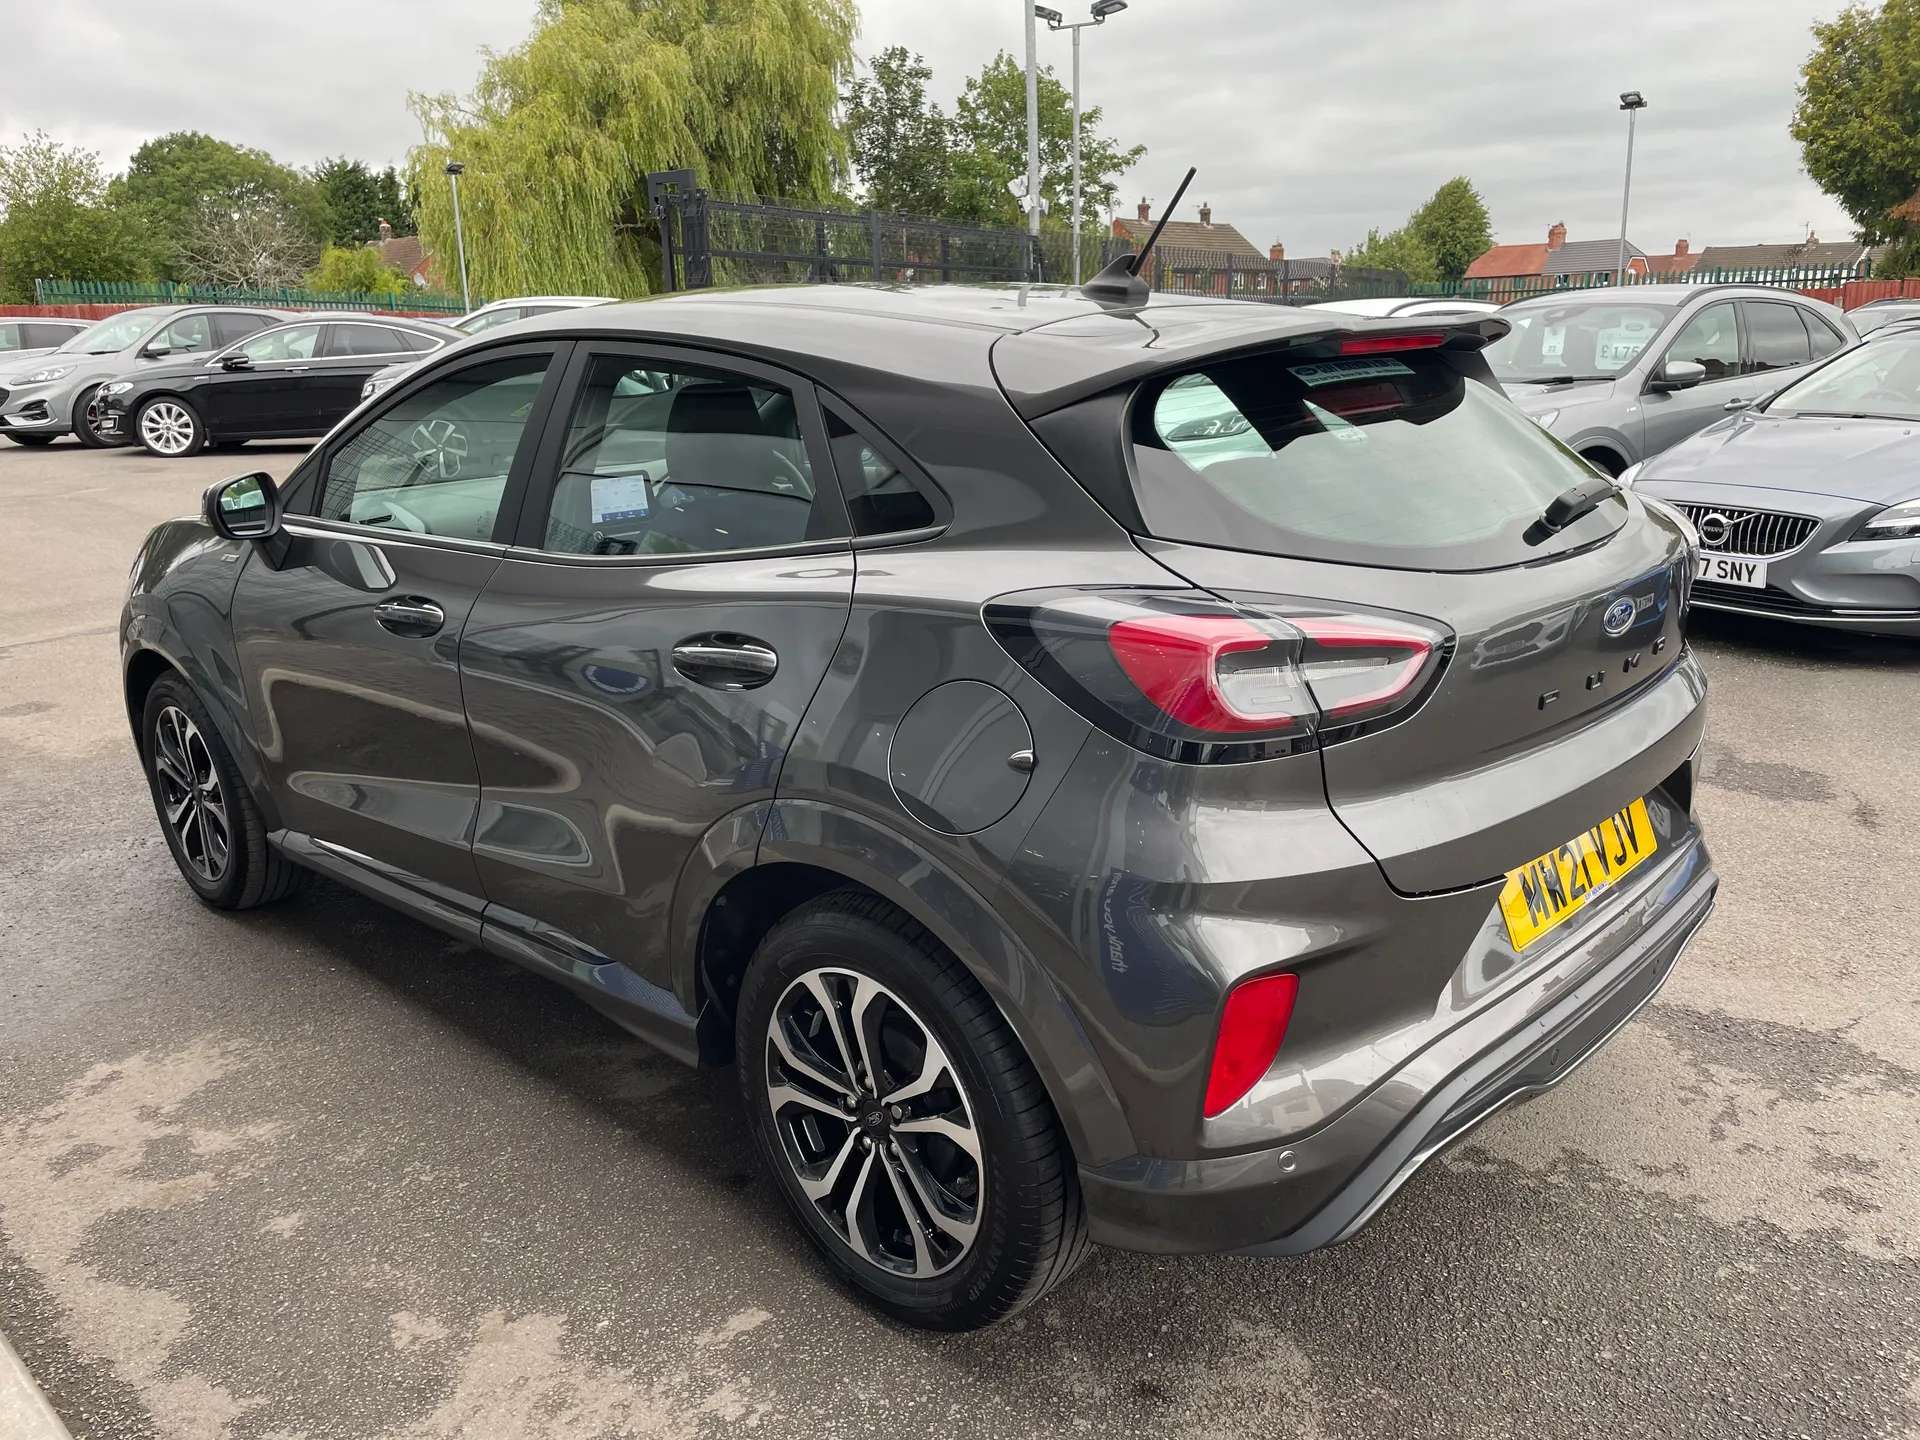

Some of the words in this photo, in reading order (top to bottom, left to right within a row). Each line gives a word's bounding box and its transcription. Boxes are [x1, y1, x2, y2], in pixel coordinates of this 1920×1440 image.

[1717, 560, 1757, 583] SNY
[1537, 636, 1666, 711] PUMA
[1519, 838, 1593, 928] MW21
[1590, 806, 1639, 876] VJV
